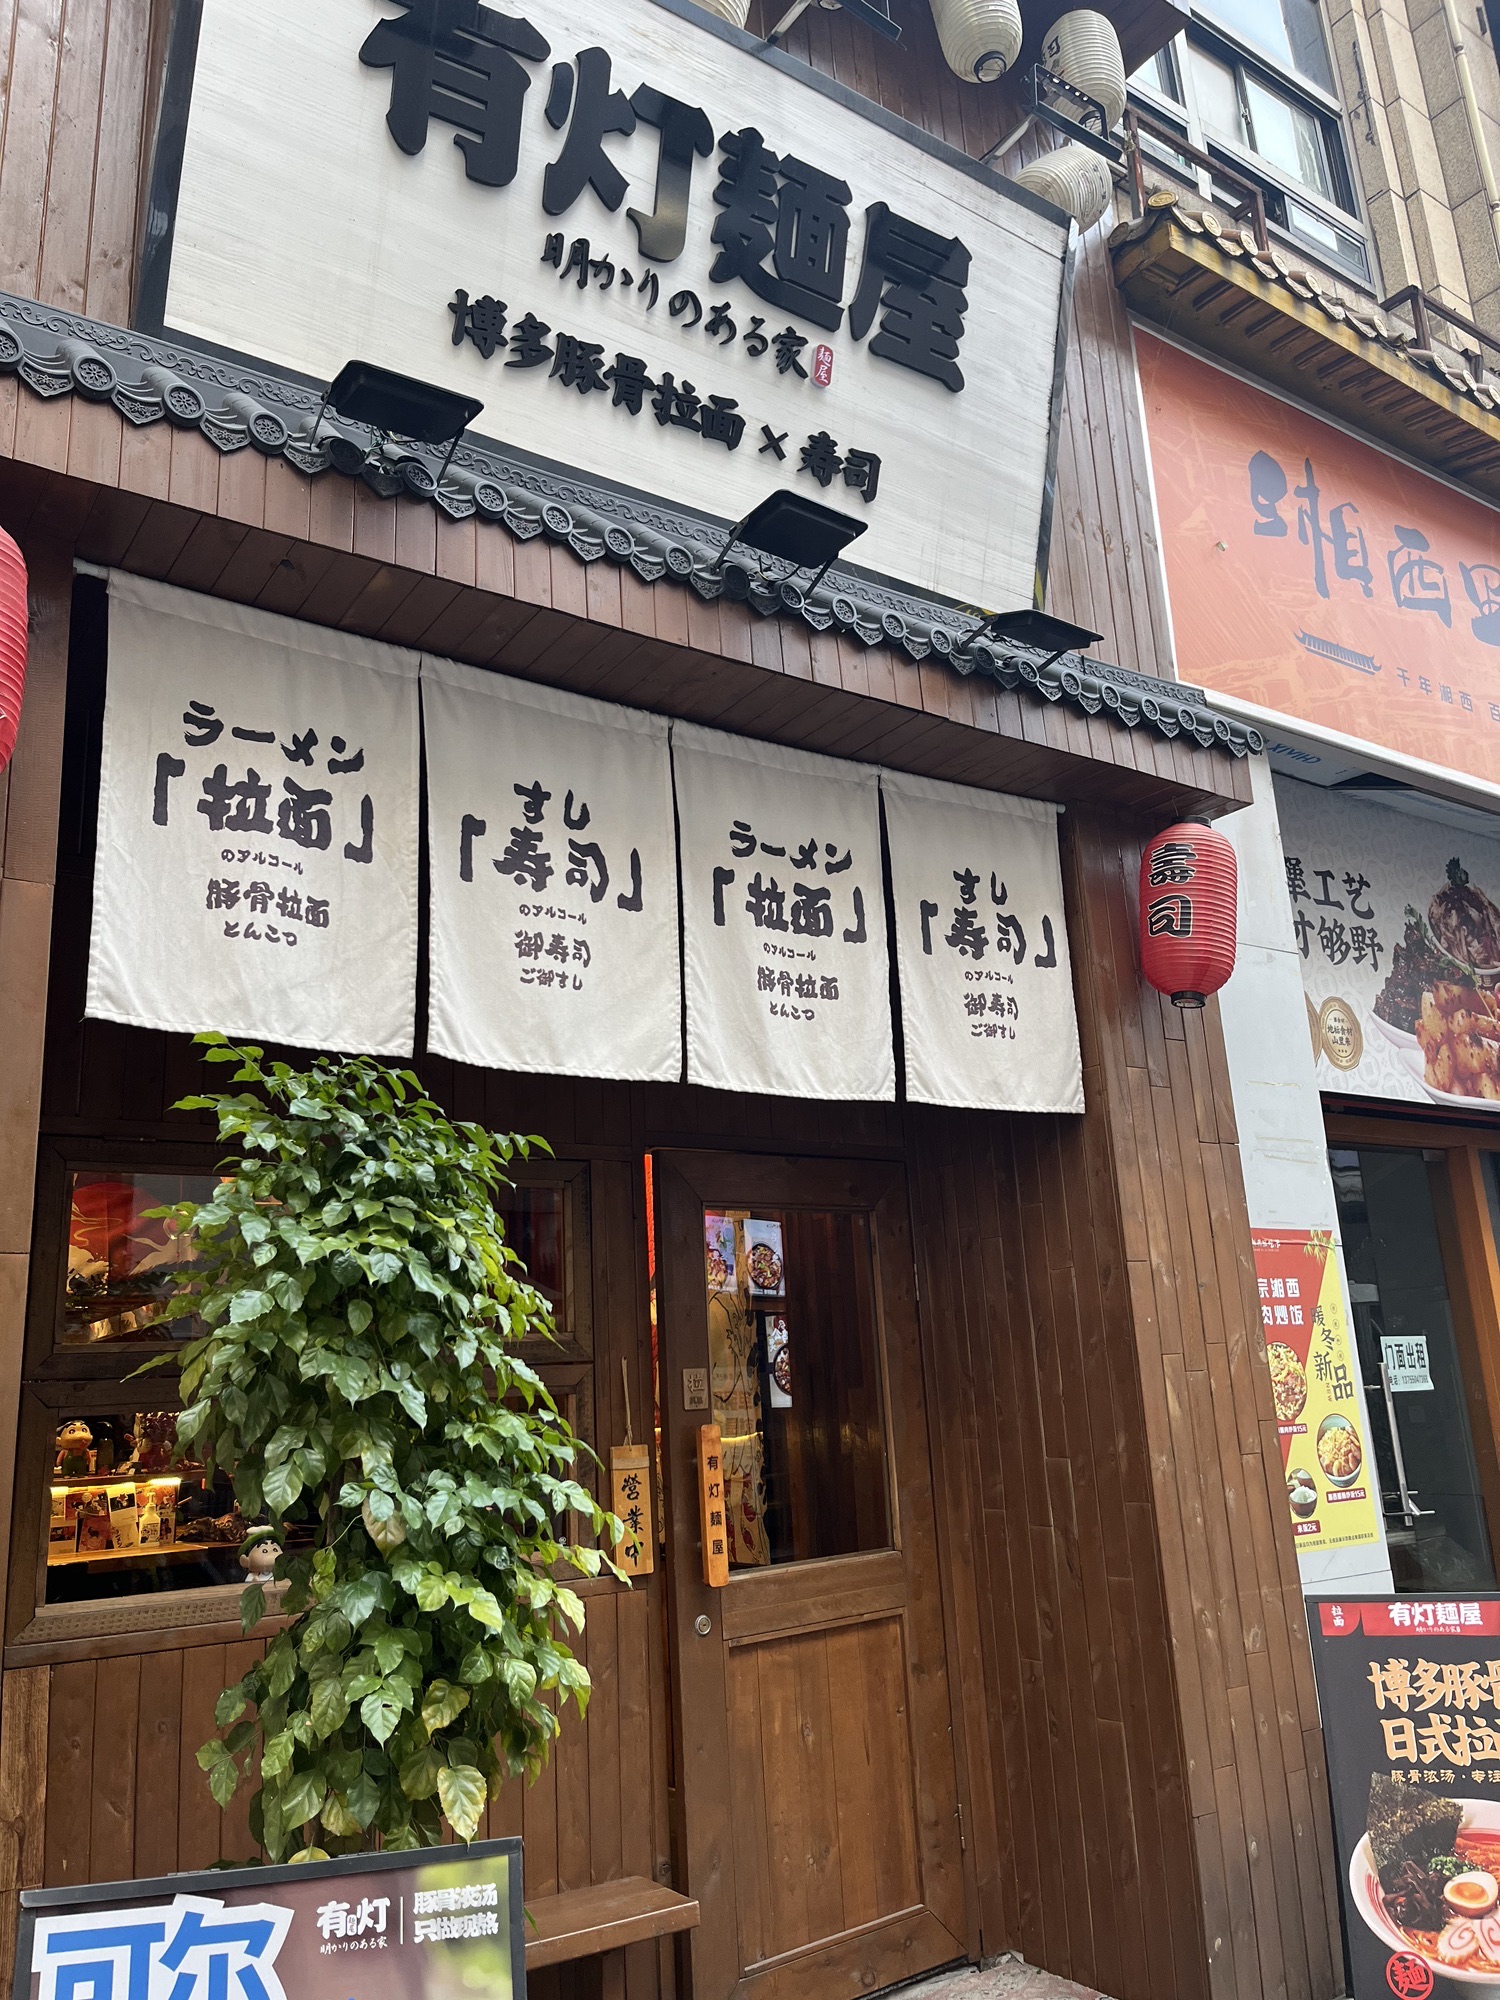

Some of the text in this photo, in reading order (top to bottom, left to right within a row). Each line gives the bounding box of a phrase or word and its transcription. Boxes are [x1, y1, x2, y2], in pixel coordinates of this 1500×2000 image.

[539, 233, 809, 379] 明かりのある家
[448, 289, 747, 451] 博多豚骨拉面
[797, 431, 882, 503] 寿司
[1396, 666, 1474, 712] 千年湘西
[183, 700, 365, 765] ラーメン
[514, 780, 591, 831] すし
[221, 848, 304, 876] のアルコール
[729, 820, 853, 875] ラーメン
[952, 867, 1008, 906] すし
[206, 878, 330, 928] 豚骨拉面
[519, 904, 588, 925] のアルコール
[223, 920, 298, 947] とんこつ
[514, 929, 592, 968] 御寿司
[763, 942, 817, 961] のアルコール
[757, 965, 839, 1000] 豚骨拉面
[964, 970, 1013, 985] のアルコール
[769, 1001, 815, 1021] とんこつ
[963, 992, 1019, 1021] 御寿司
[1261, 1304, 1304, 1325] 肉炒饭
[1384, 1342, 1427, 1370] 门面出租
[687, 1374, 705, 1393] 拉
[1331, 1605, 1345, 1626] 拉面
[1380, 1712, 1500, 1766] 日式拉
[316, 1897, 390, 1941] 有灯
[413, 1911, 499, 1943] 只做现熬
[320, 1936, 389, 1955] 明かりのある家
